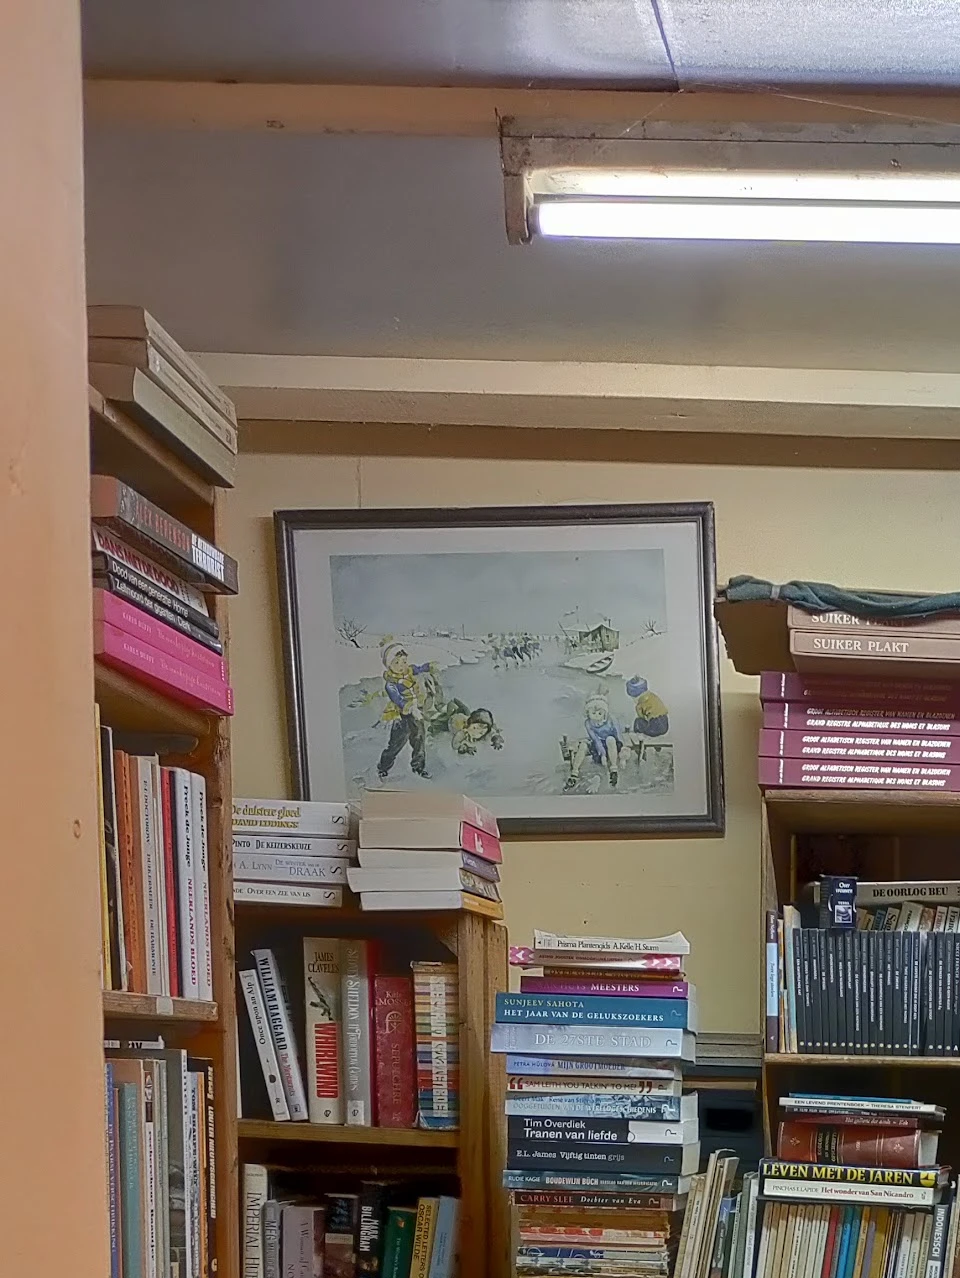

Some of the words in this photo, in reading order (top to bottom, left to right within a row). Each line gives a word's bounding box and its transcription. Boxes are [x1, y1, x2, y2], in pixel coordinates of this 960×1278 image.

[814, 639, 862, 651] SUIKER
[868, 641, 909, 652] PLAKT
[881, 766, 892, 774] VAN
[232, 839, 251, 848] PINTO
[256, 840, 264, 849] DE
[266, 841, 312, 850] KEIZERSKEUZE
[289, 867, 326, 877] DRAAK
[872, 887, 887, 898] DE
[889, 887, 927, 897] OORLOG
[929, 886, 949, 896] BEU
[557, 940, 577, 948] Prisma
[578, 941, 611, 951] Plantengids
[590, 983, 640, 992] MEESTERS
[259, 957, 275, 1001] WILLIAM
[268, 1002, 287, 1050] HAGGARD
[504, 1009, 522, 1017] HET
[525, 1010, 549, 1018] JAAR
[572, 1011, 584, 1019] DE
[587, 1012, 664, 1022] GELUKSZOEKERS
[315, 1023, 338, 1098] WHIRLWIND
[523, 1118, 542, 1127] Tim
[544, 1119, 586, 1129] Overdiek
[523, 1127, 563, 1140] Tranen
[564, 1129, 585, 1140] van
[587, 1129, 618, 1141] liefde
[516, 1150, 530, 1158] E.L.
[532, 1151, 557, 1159] James
[560, 1151, 583, 1161] Vijftig
[583, 1152, 607, 1161] tinten
[607, 1153, 625, 1162] grijs
[763, 1163, 809, 1179] LEVEN
[813, 1164, 845, 1181] MET
[847, 1166, 867, 1182] DE
[868, 1169, 913, 1184] JAREN
[772, 1185, 797, 1193] PINCHAS
[820, 1186, 833, 1194] Het
[870, 1189, 883, 1197] San
[883, 1191, 914, 1199] Nicandro
[520, 1194, 552, 1203] CARRY
[554, 1195, 573, 1203] SLEE
[580, 1195, 608, 1203] Dochter
[245, 1192, 262, 1250] IMPERIAL
[932, 1208, 945, 1257] INDONESISCH
